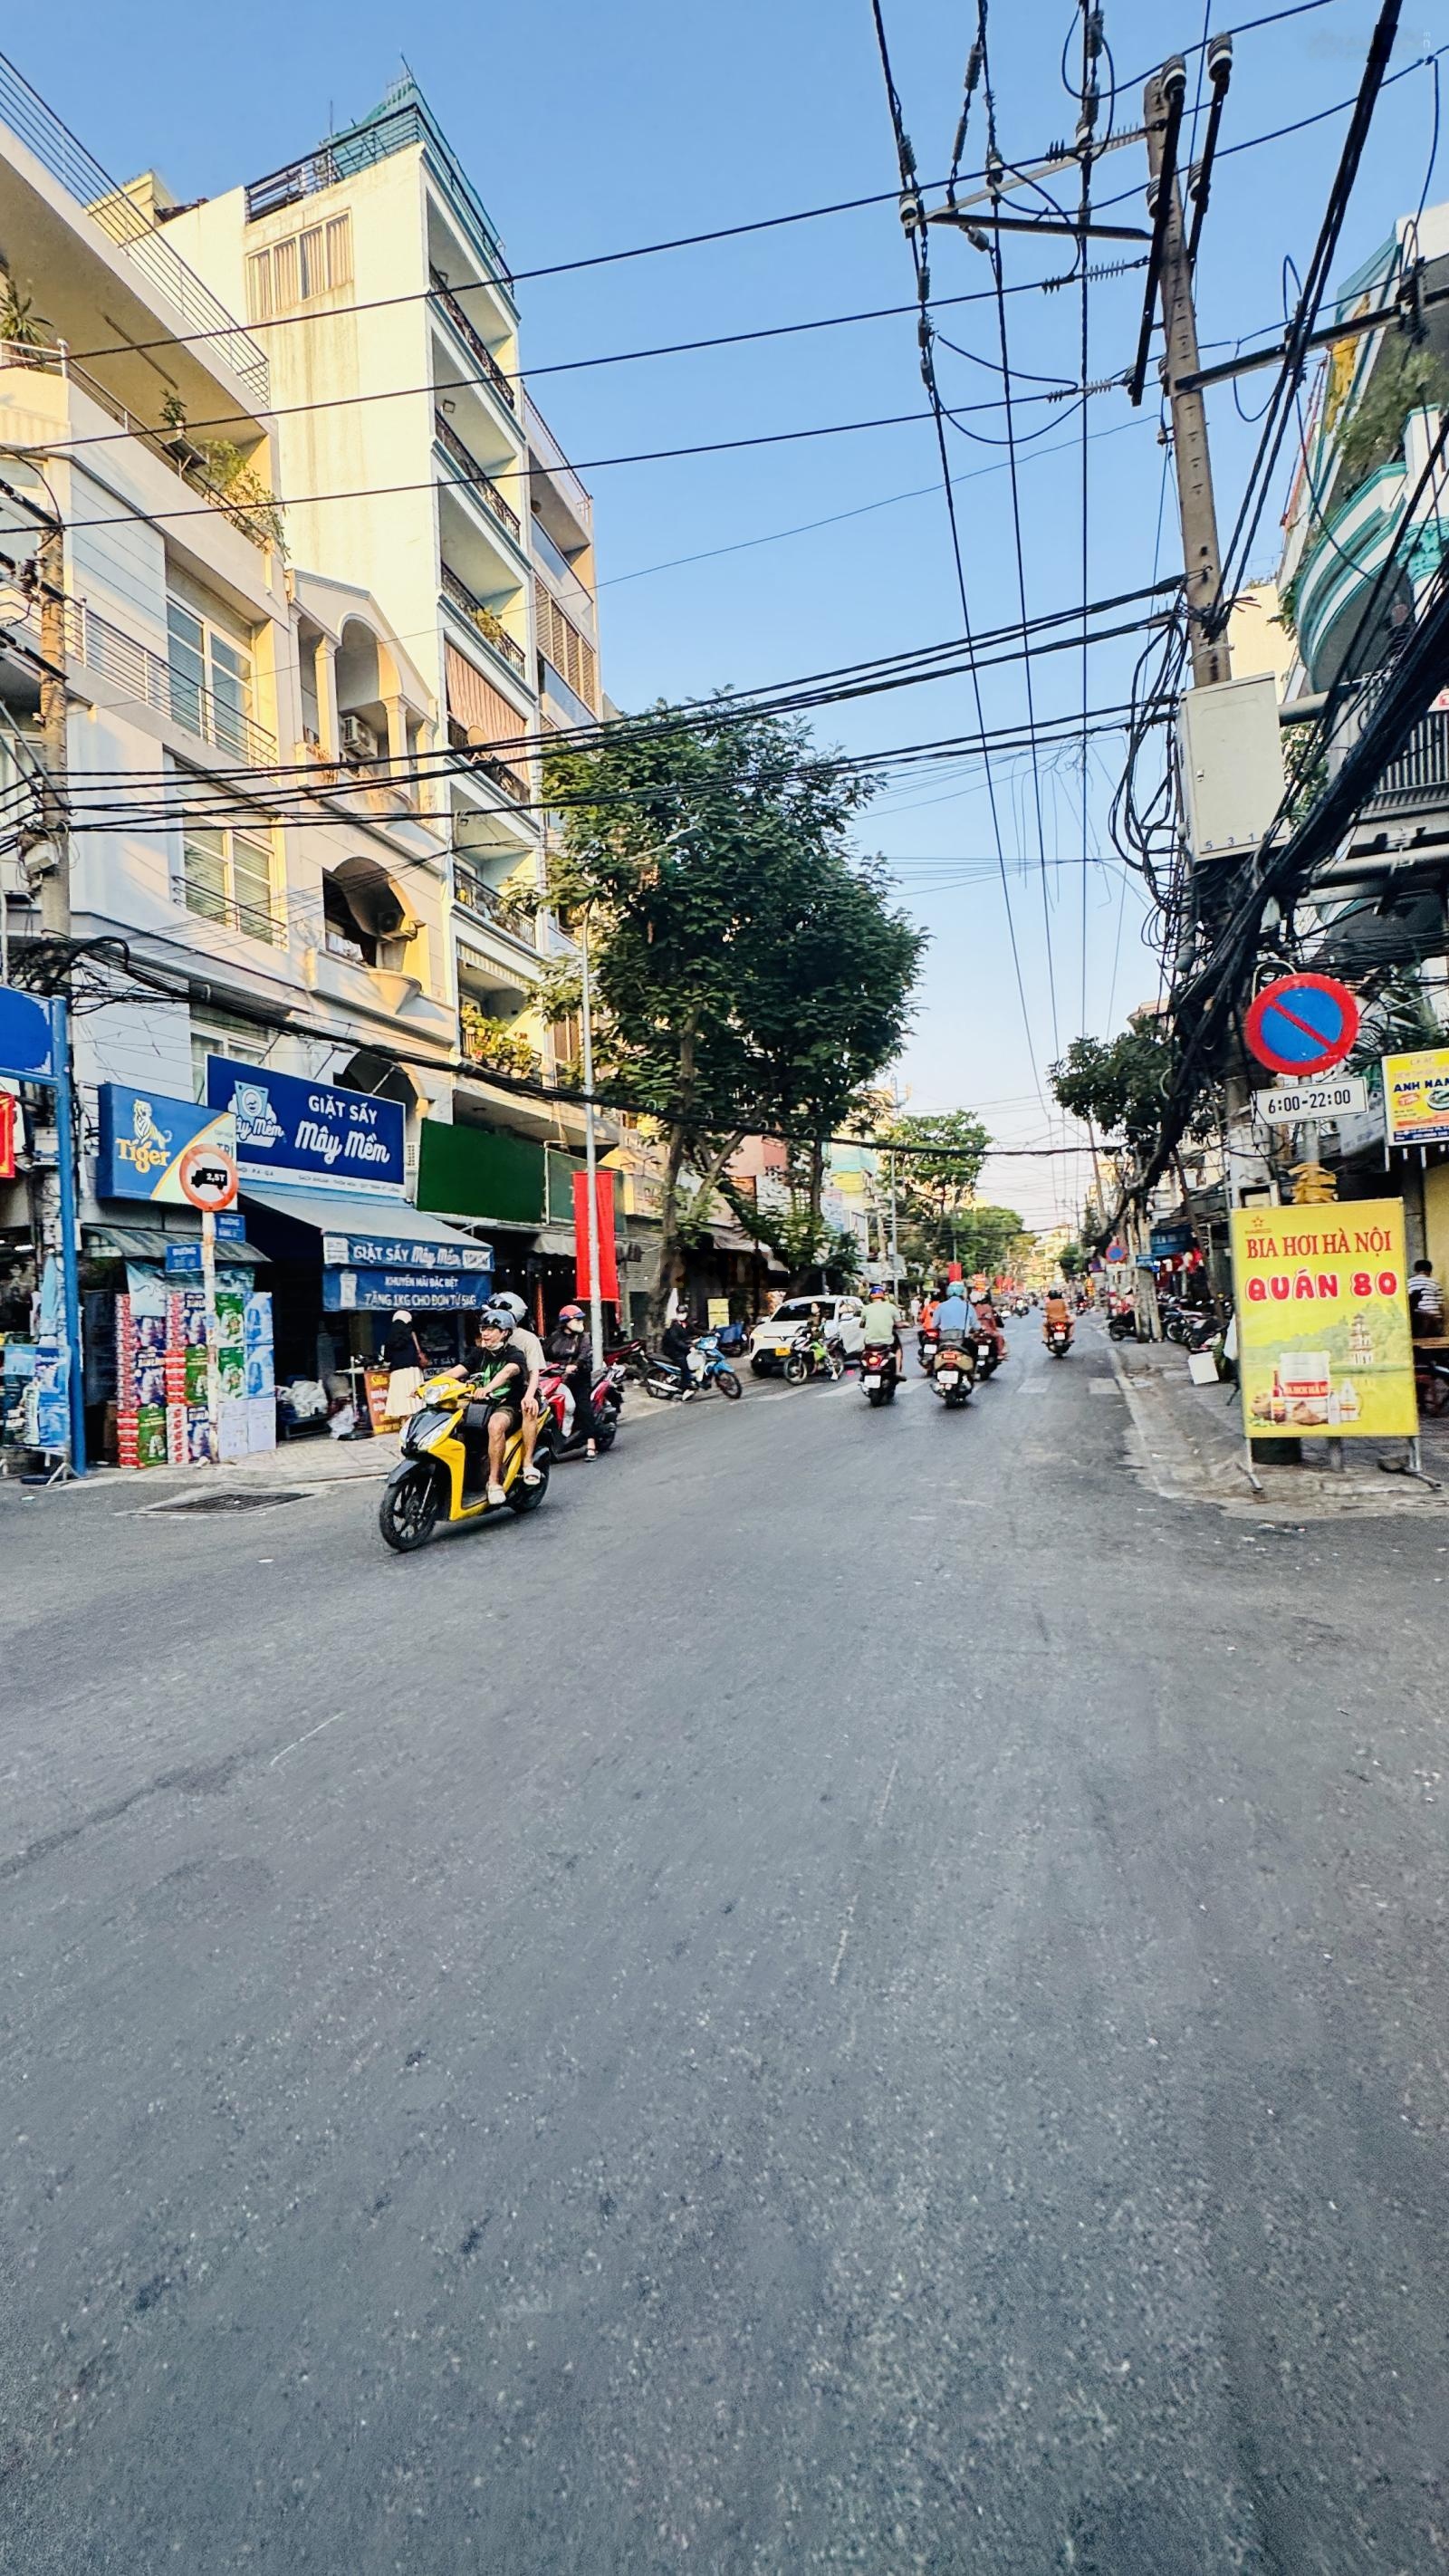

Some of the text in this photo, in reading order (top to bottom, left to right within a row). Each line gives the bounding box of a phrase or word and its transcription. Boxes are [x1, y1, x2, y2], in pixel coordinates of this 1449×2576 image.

[1204, 832, 1254, 850] 5 3 1
[1393, 1081, 1421, 1093] ANH
[308, 1094, 378, 1125] GIẶT SẤY
[1268, 1089, 1351, 1114] 6:00-22:00
[235, 1116, 252, 1140] ây
[294, 1120, 390, 1165] Mây Mềm
[115, 1137, 171, 1174] Tiger
[206, 1172, 226, 1183] 2,5T
[353, 1243, 384, 1264] GIẶT
[385, 1243, 408, 1262] SẤY
[1246, 1226, 1392, 1259] BIA HƠI HÀ NỘI
[1247, 1269, 1398, 1302] QUÁN 80
